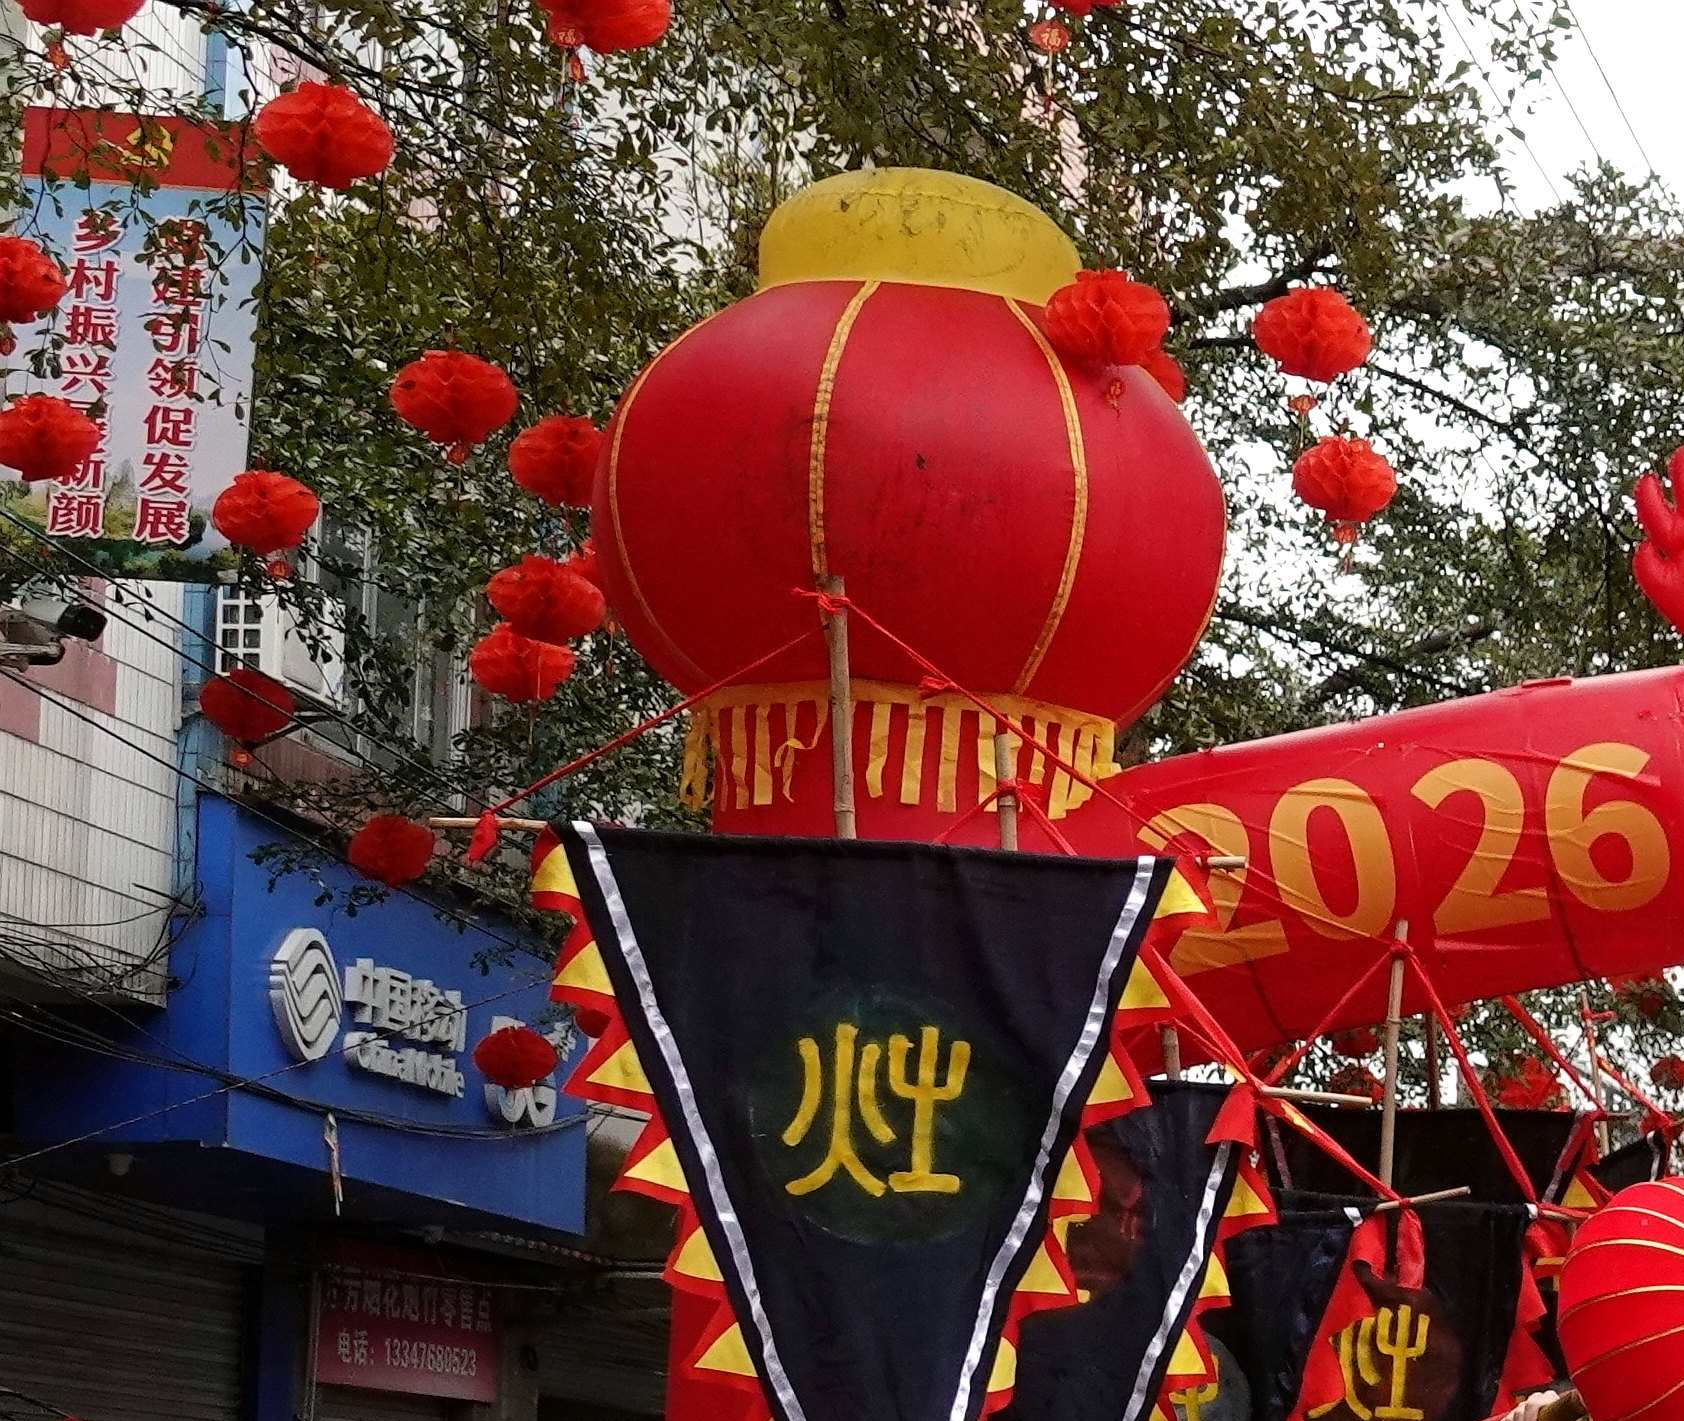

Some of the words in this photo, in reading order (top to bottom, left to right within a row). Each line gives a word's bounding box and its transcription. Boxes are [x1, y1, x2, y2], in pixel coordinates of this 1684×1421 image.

[49, 212, 121, 536] 乡村振兴新颜
[345, 957, 468, 1053] 中国移动
